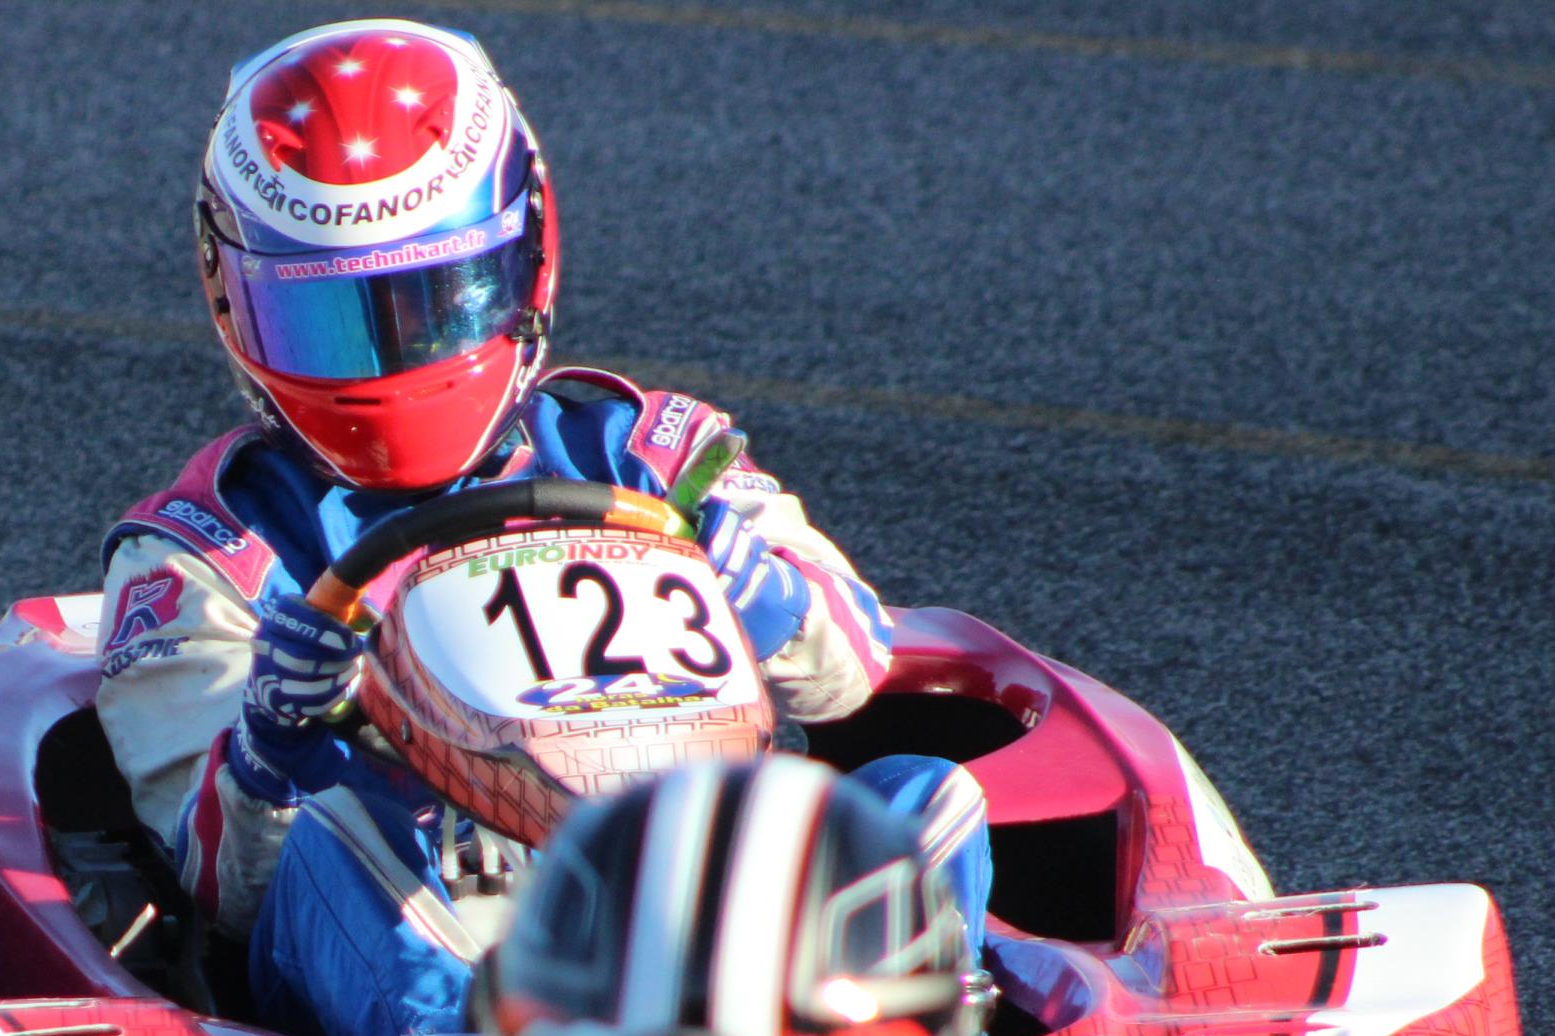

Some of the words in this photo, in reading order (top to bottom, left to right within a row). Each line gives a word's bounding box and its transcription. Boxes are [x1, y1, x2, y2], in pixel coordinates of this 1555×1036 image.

[286, 173, 446, 226] COFANOR
[275, 228, 486, 280] www.technikart.fr
[160, 500, 249, 554] sparco
[467, 542, 652, 578] EUROINDY
[482, 560, 733, 681] 123
[547, 672, 664, 705] 24
